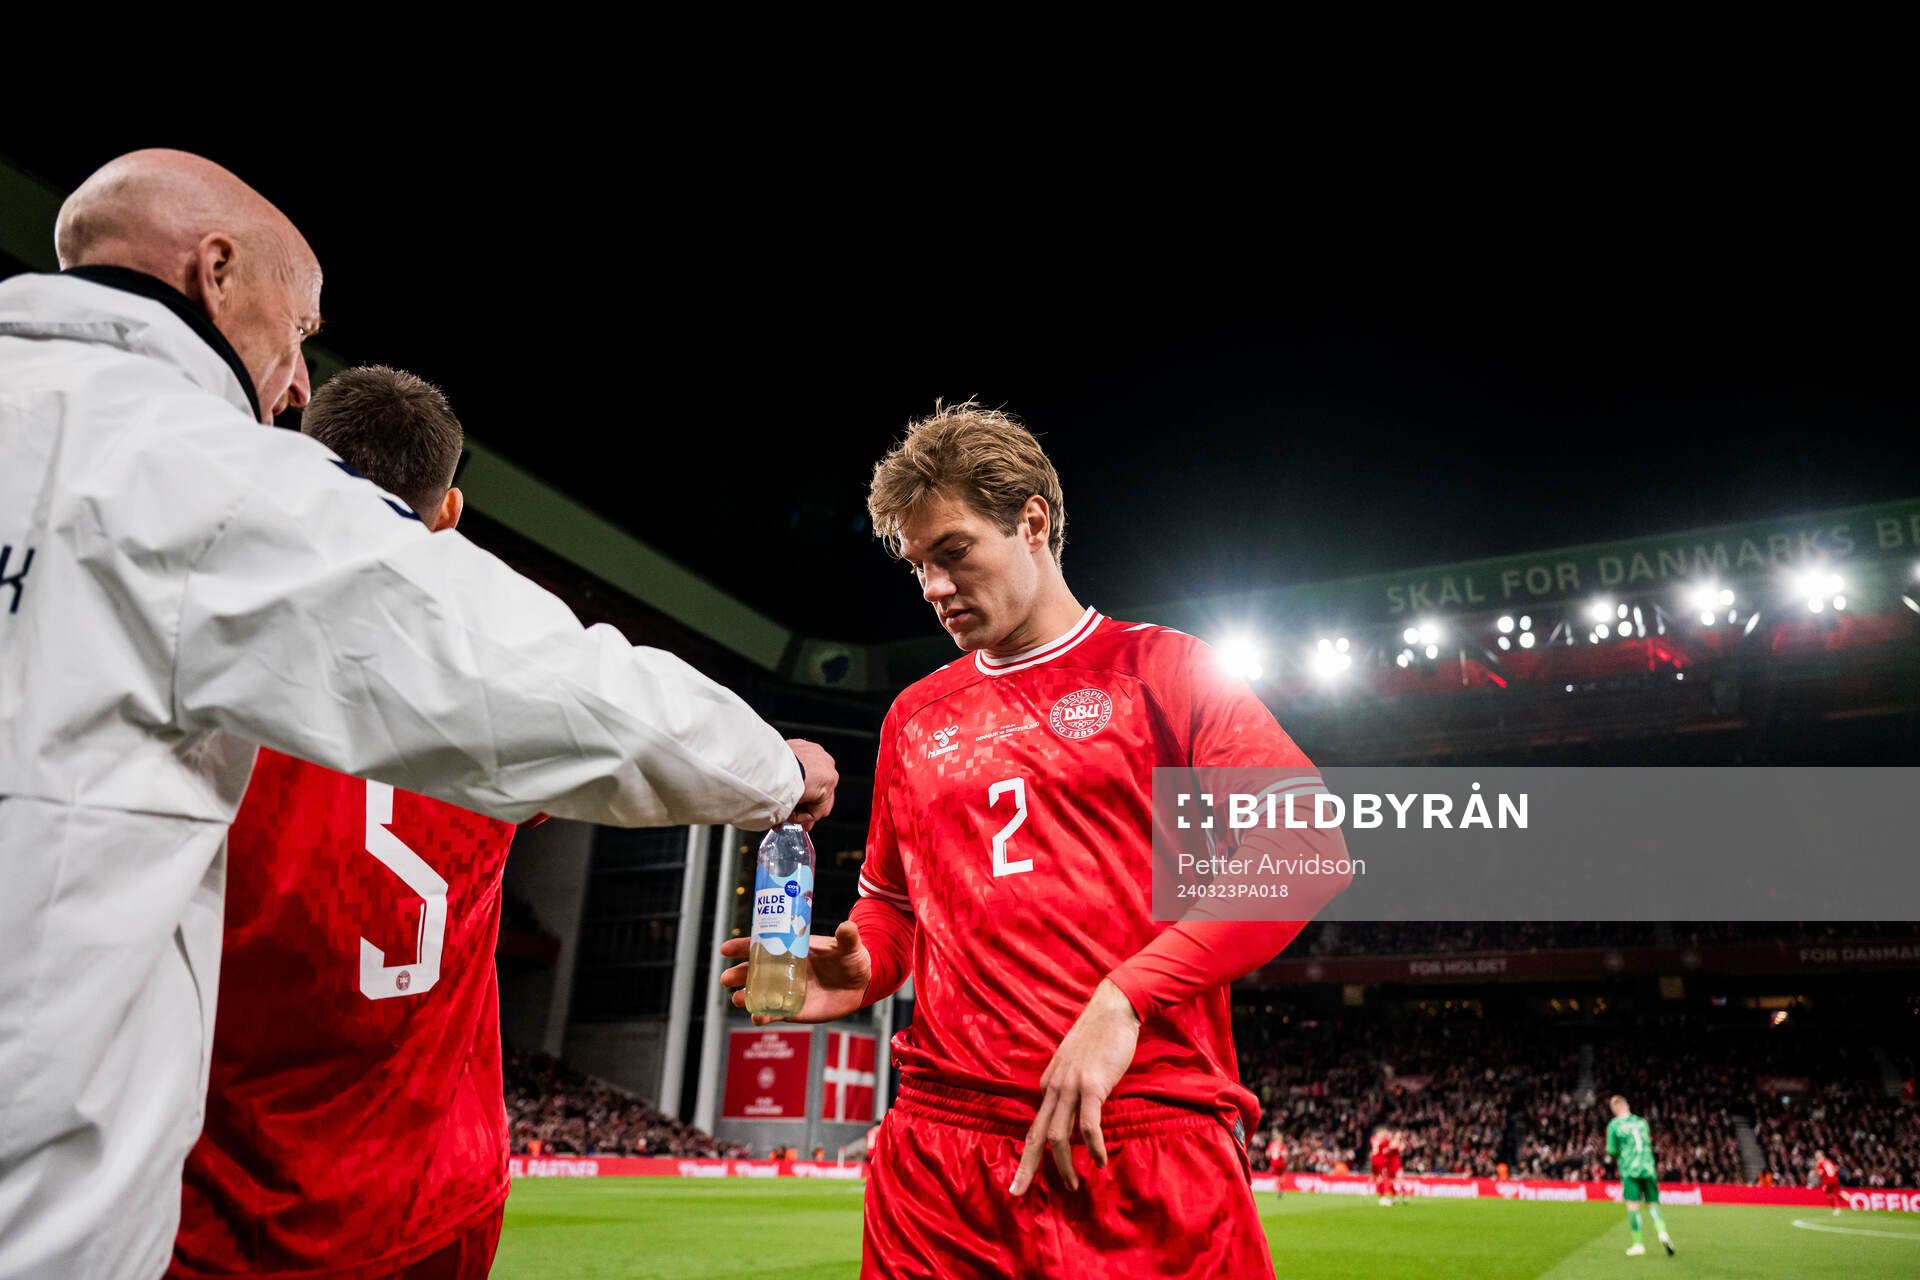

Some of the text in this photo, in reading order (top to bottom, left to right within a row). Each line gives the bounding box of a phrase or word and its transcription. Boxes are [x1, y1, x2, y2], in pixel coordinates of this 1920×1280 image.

[1501, 561, 1581, 598] FOR
[1598, 524, 1856, 586] DANMARKS
[1062, 703, 1100, 721] DBU
[988, 777, 1034, 878] 2
[757, 895, 785, 906] KILDE
[757, 905, 785, 915] VÆLD
[1799, 947, 1839, 964] FOR
[1408, 958, 1507, 976] FOR HOLDET
